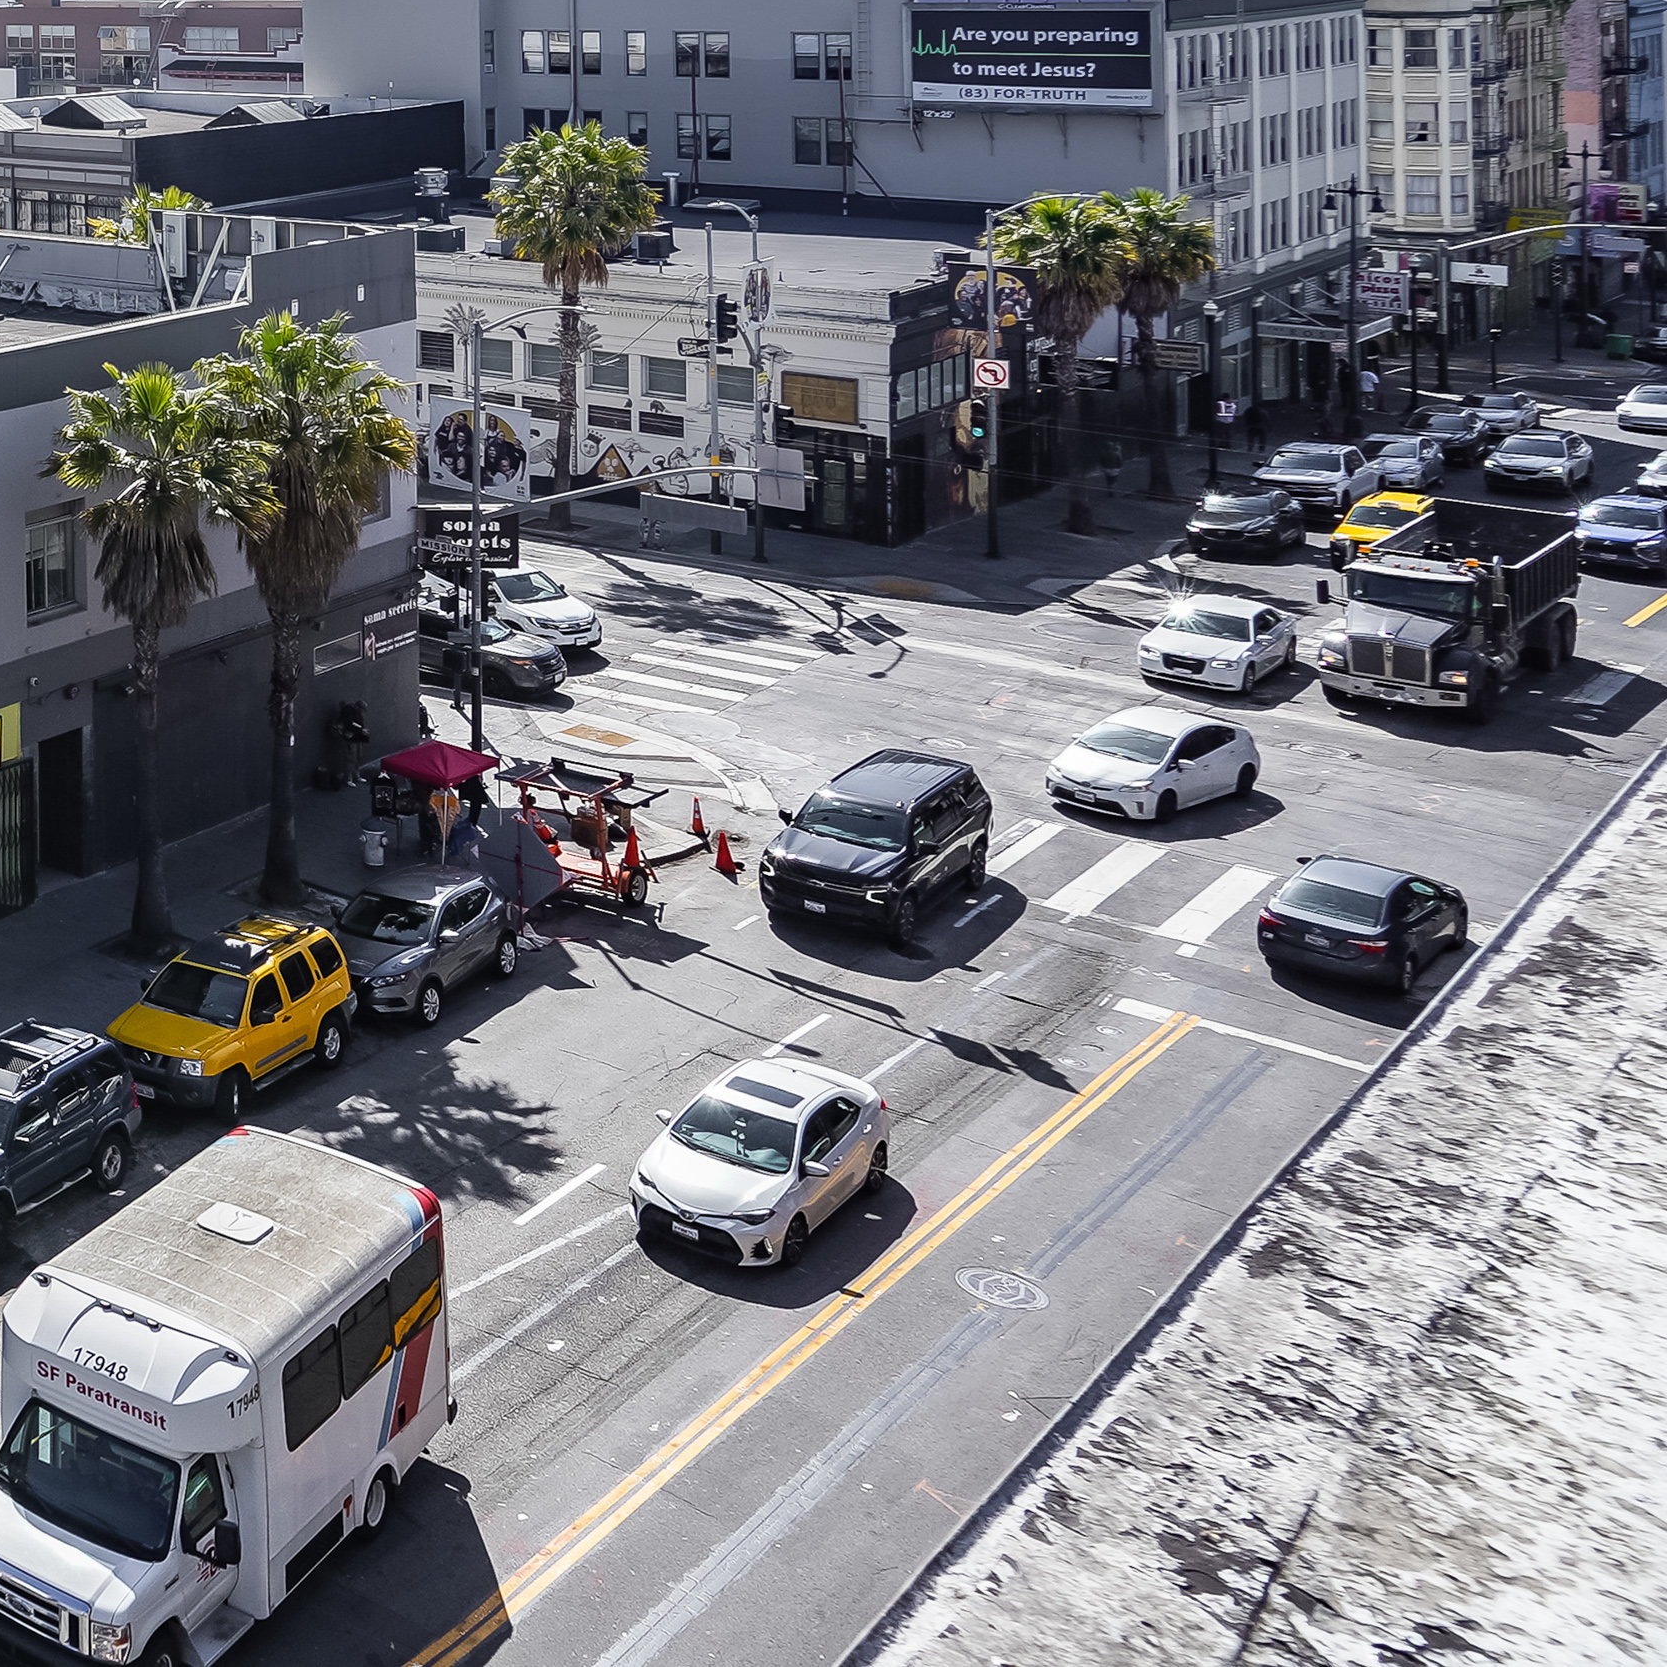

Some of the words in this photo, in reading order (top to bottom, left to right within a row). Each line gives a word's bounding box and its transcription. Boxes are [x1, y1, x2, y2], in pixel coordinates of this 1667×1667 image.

[952, 26, 986, 41] Are
[991, 29, 1028, 45] you
[1034, 27, 1138, 45] preparing
[953, 62, 973, 76] to
[978, 62, 1027, 76] meet
[1031, 62, 1096, 78] Jesus?
[958, 87, 989, 100] (83)
[994, 88, 1087, 101] FOR-TRUTH
[421, 539, 466, 555] MISSION
[72, 1347, 129, 1382] 17948
[36, 1360, 60, 1382] SF
[66, 1372, 167, 1431] Paratransit
[226, 1382, 261, 1420] 17948
